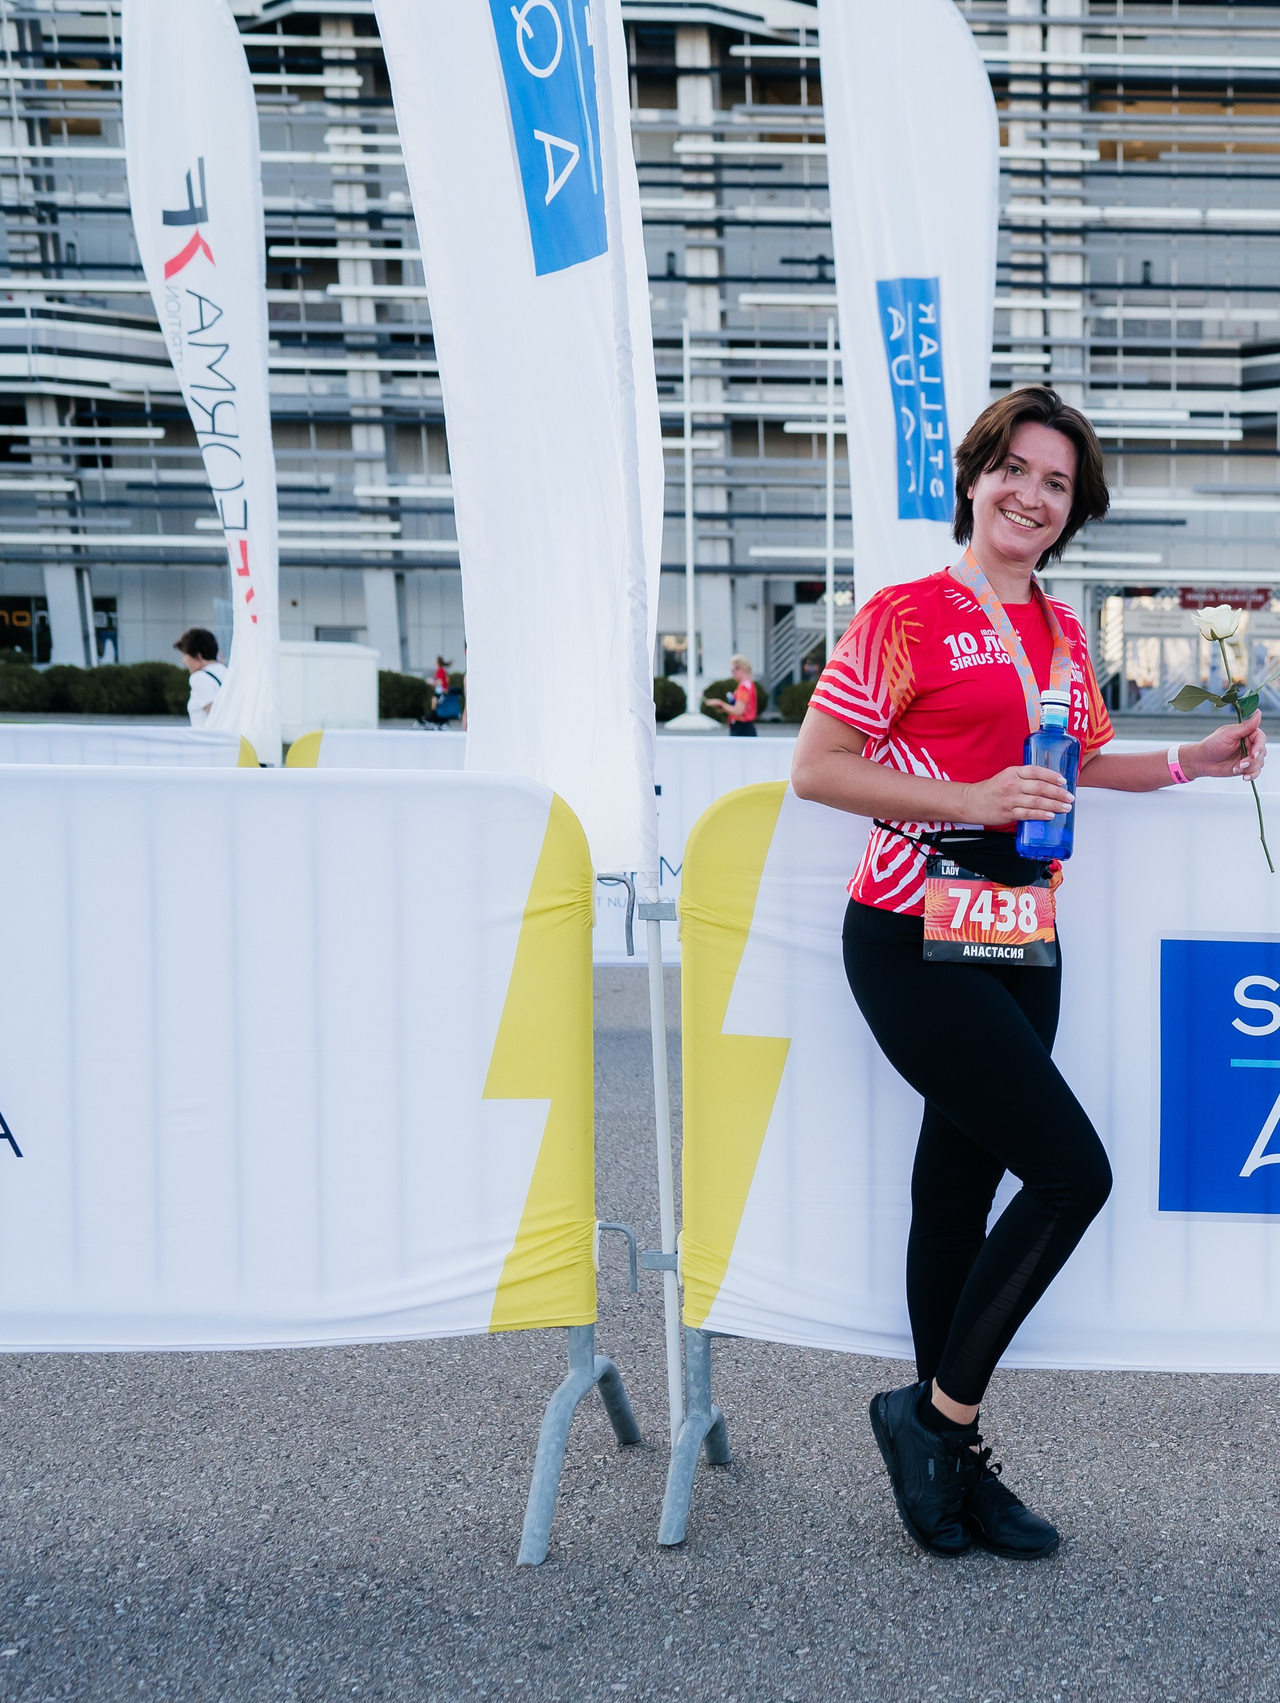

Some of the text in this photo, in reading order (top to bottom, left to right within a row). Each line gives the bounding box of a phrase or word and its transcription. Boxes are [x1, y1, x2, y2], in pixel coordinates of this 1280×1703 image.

[943, 632, 978, 658] 10
[949, 653, 994, 672] SIRIUS
[1073, 689, 1089, 711] 20
[941, 866, 960, 876] LADY
[948, 887, 1038, 934] 7438
[962, 945, 1024, 959] АНАСТАСИЯ
